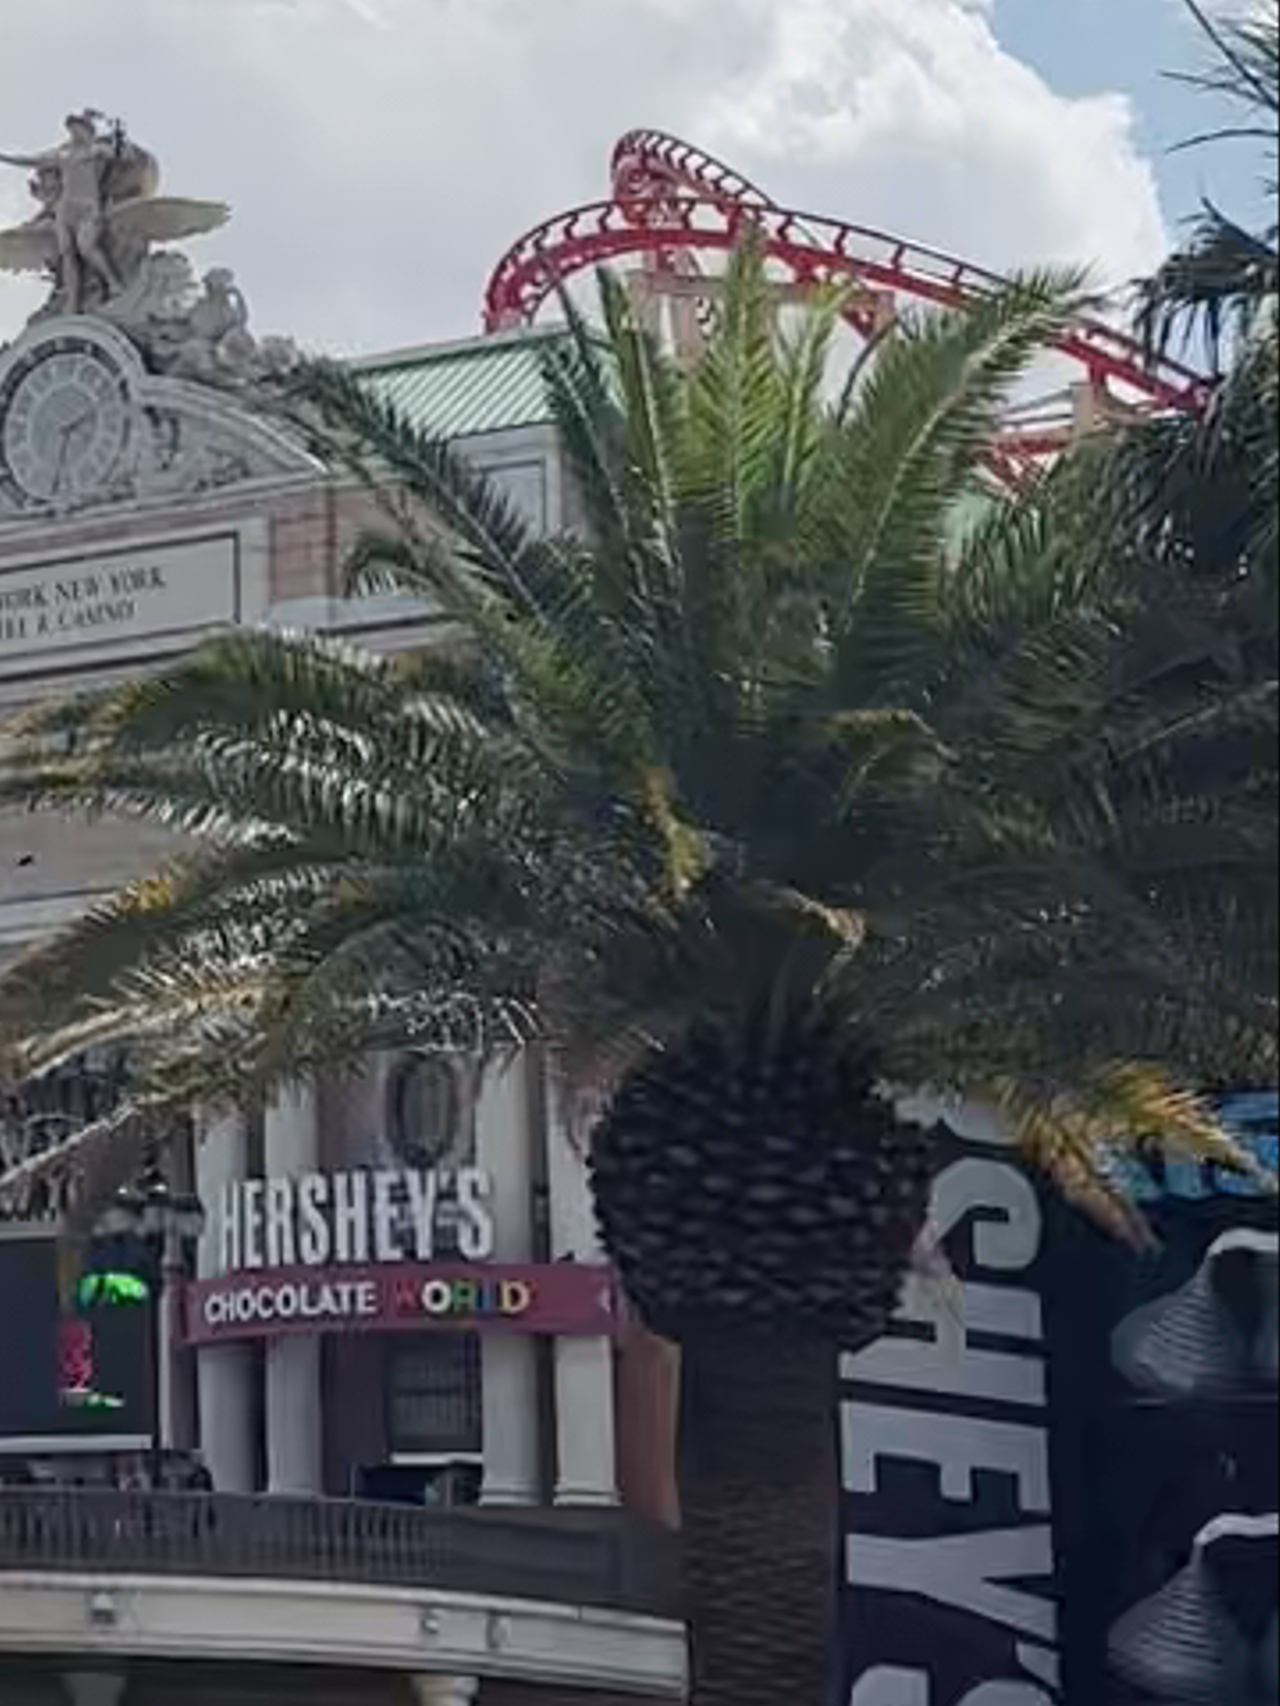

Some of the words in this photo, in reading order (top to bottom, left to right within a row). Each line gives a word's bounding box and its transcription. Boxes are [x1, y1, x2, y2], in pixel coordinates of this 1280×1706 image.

[54, 574, 103, 603] NEW
[109, 566, 167, 594] YORK
[220, 1166, 495, 1272] HERSHEY'S
[204, 1279, 378, 1325] CHOCOLATE
[393, 1278, 531, 1316] WORLD
